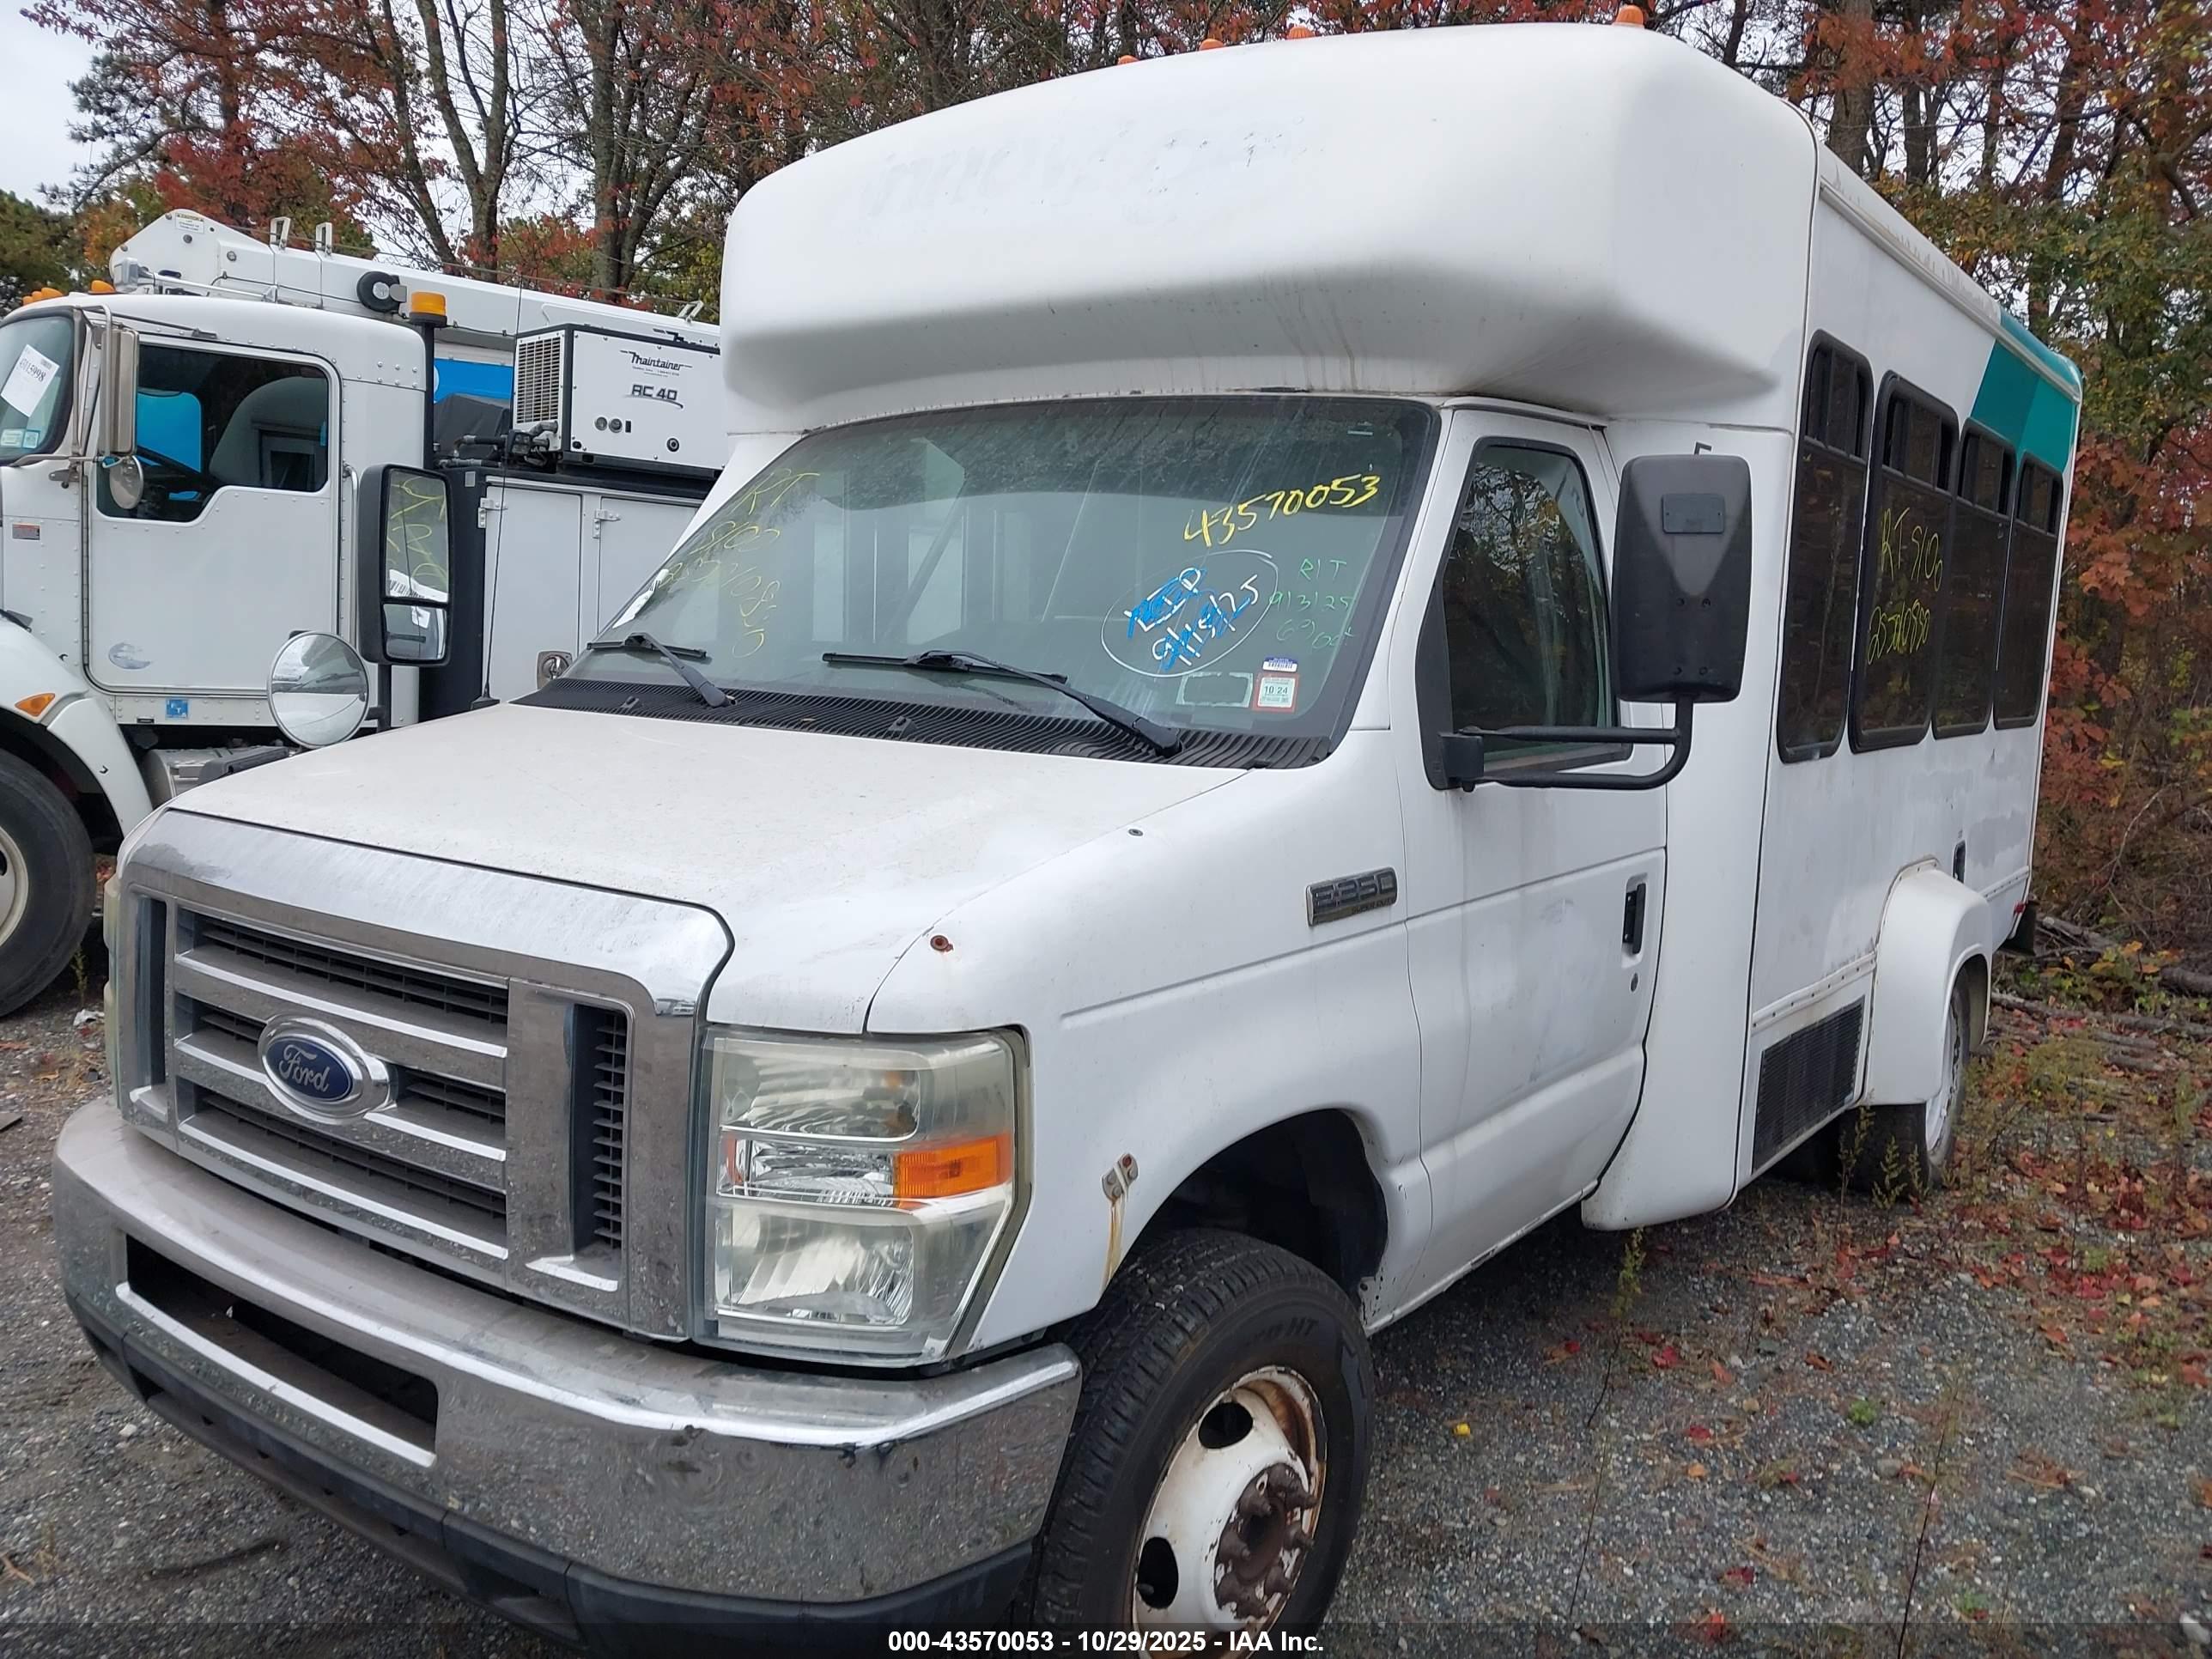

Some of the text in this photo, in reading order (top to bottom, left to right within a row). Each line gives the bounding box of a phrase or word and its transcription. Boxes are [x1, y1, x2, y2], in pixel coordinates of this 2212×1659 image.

[620, 349, 693, 371] Maintainer
[656, 387, 678, 401] 40
[1183, 474, 1380, 548] 43570053
[1264, 684, 1288, 696] 10 24
[278, 1044, 330, 1092] Ford
